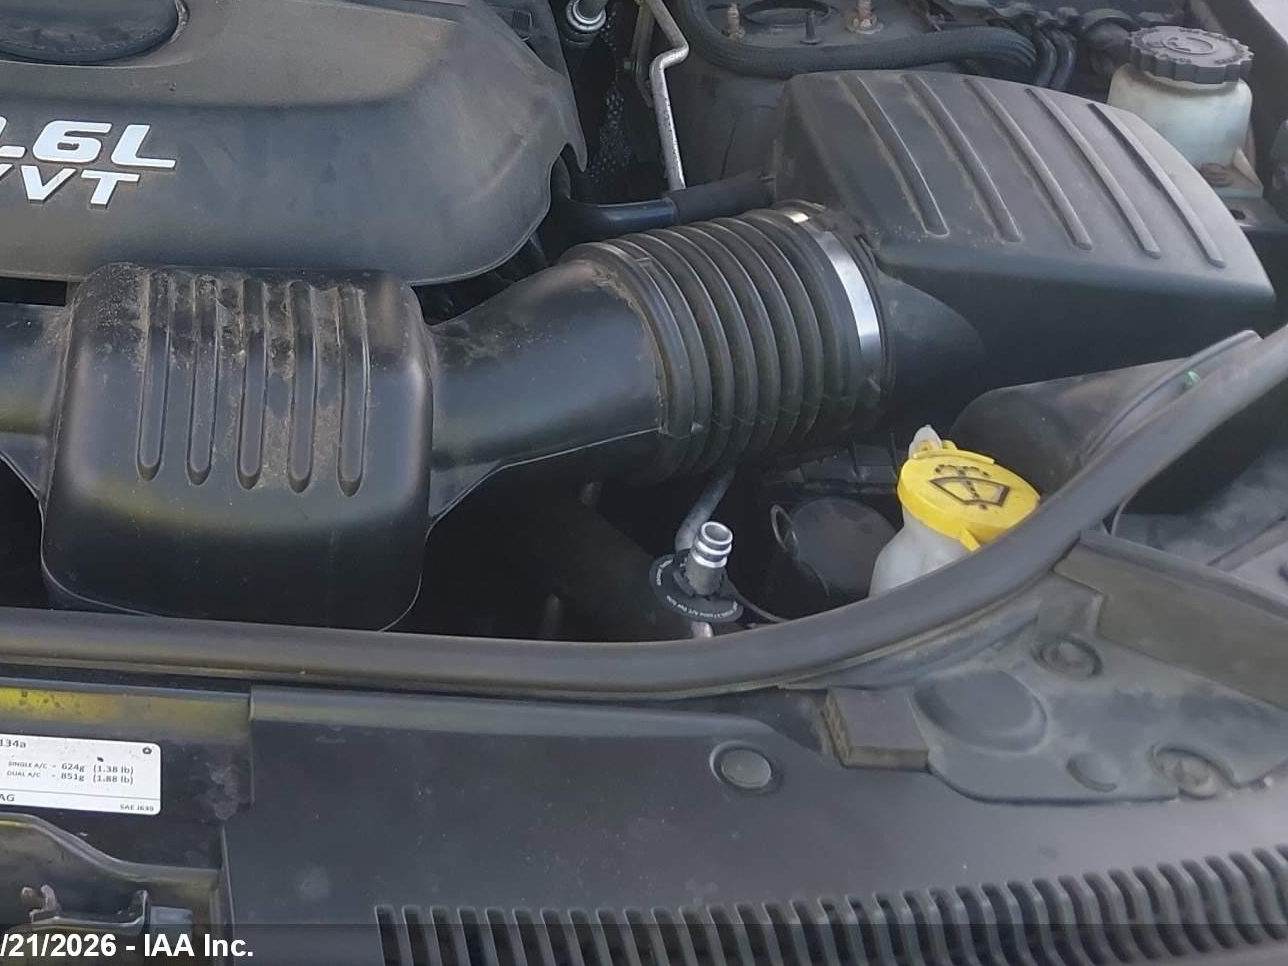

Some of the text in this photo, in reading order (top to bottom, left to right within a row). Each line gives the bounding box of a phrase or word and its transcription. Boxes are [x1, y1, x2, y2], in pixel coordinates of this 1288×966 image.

[8, 761, 33, 769] SINGLE
[34, 762, 48, 770] A/C
[61, 762, 86, 773] 624g
[93, 764, 118, 775] (1.38
[120, 766, 134, 776] lb)
[6, 770, 26, 778] DUAL
[60, 772, 85, 782] 851g
[93, 774, 118, 784] (1.88
[120, 775, 134, 785] lb)
